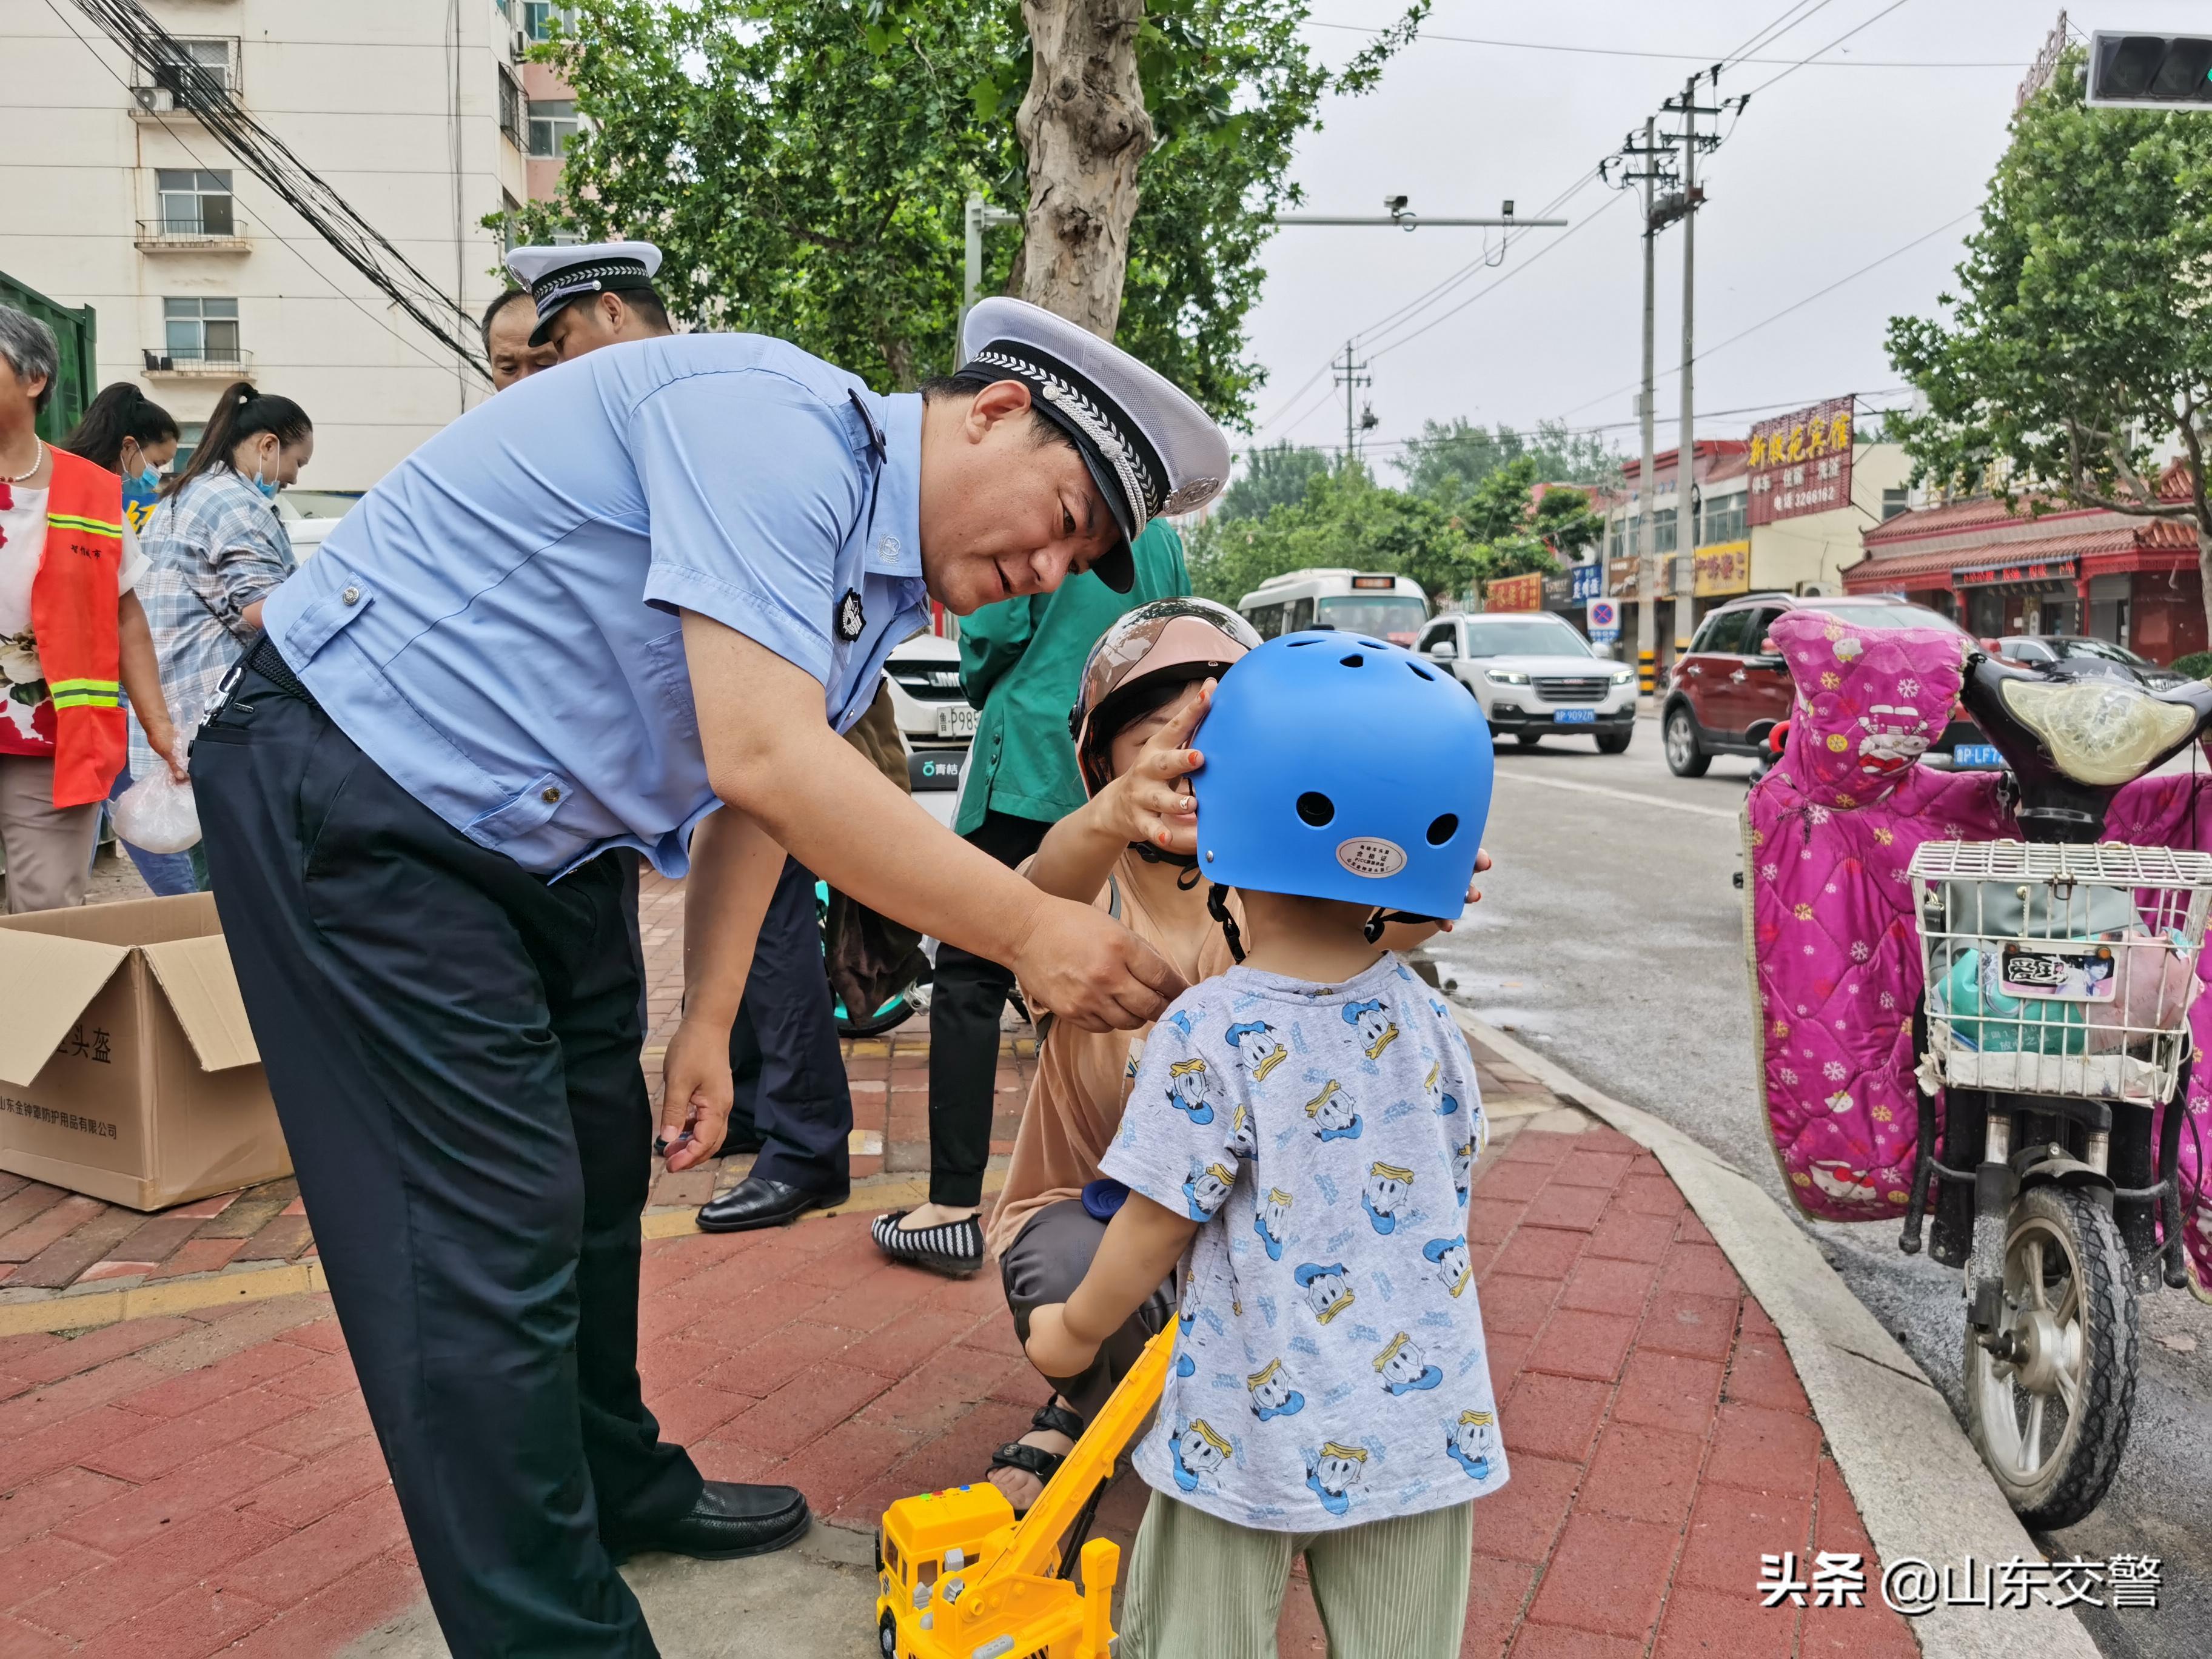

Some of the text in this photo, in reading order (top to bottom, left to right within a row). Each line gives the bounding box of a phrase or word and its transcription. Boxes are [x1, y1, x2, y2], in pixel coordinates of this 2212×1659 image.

[936, 763, 959, 776] 青桔
[1356, 851, 1387, 862] 合格证
[0, 1096, 116, 1140] 山东金钟罩防护用品有限公司
